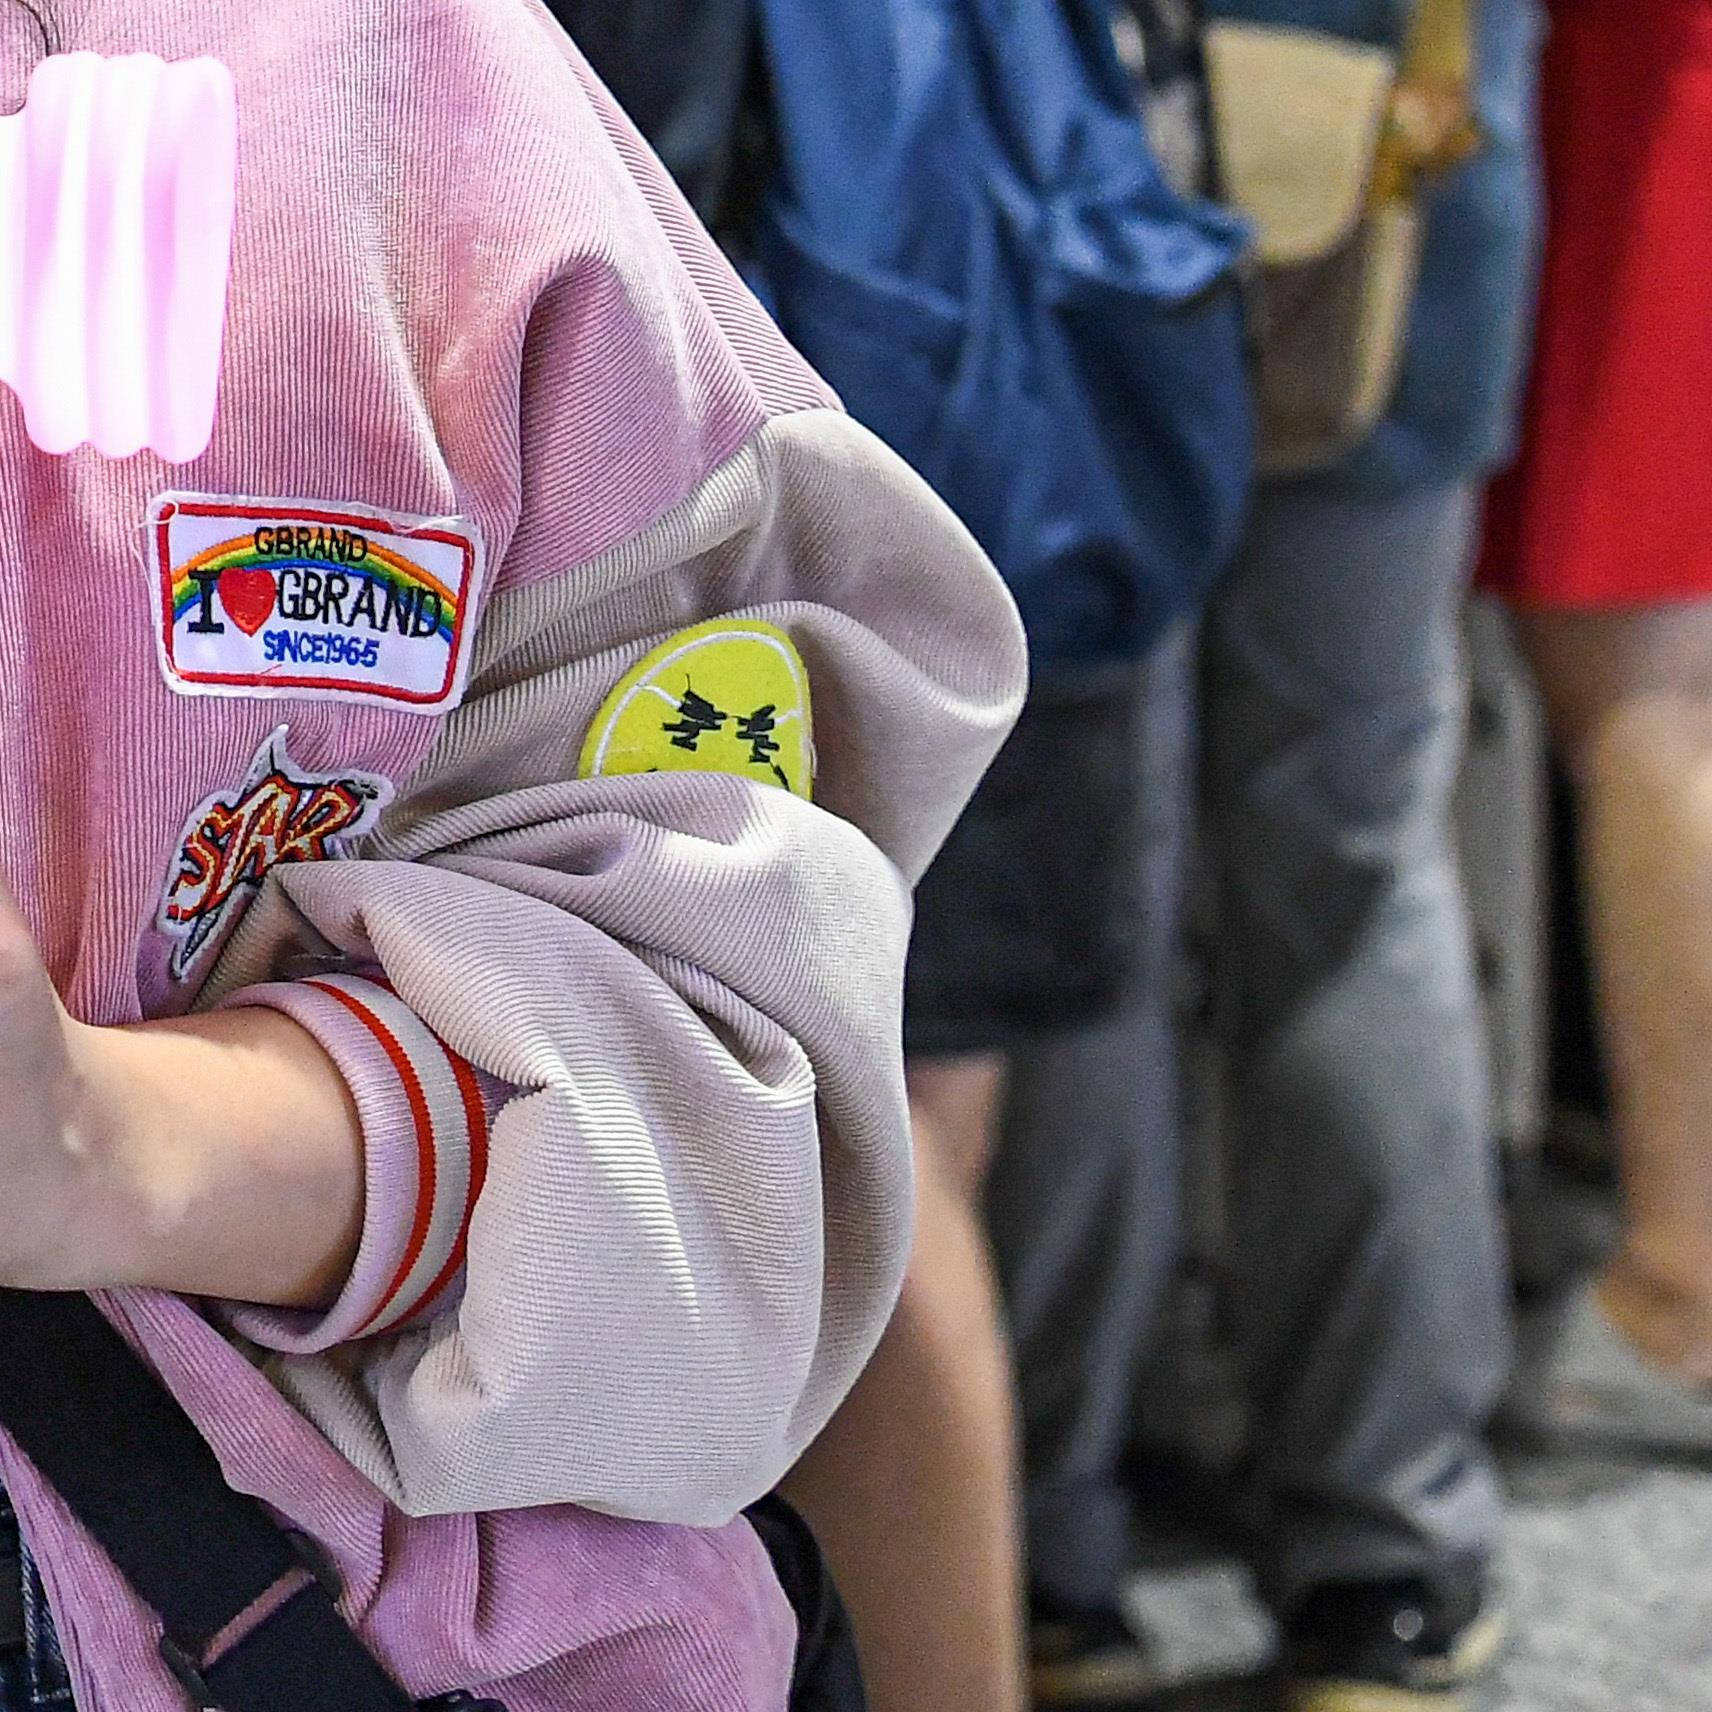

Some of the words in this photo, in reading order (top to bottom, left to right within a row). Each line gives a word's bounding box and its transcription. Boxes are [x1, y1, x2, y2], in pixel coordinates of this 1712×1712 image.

[254, 526, 368, 563] GBRAND
[187, 568, 225, 634] I
[278, 568, 442, 638] GBRAND
